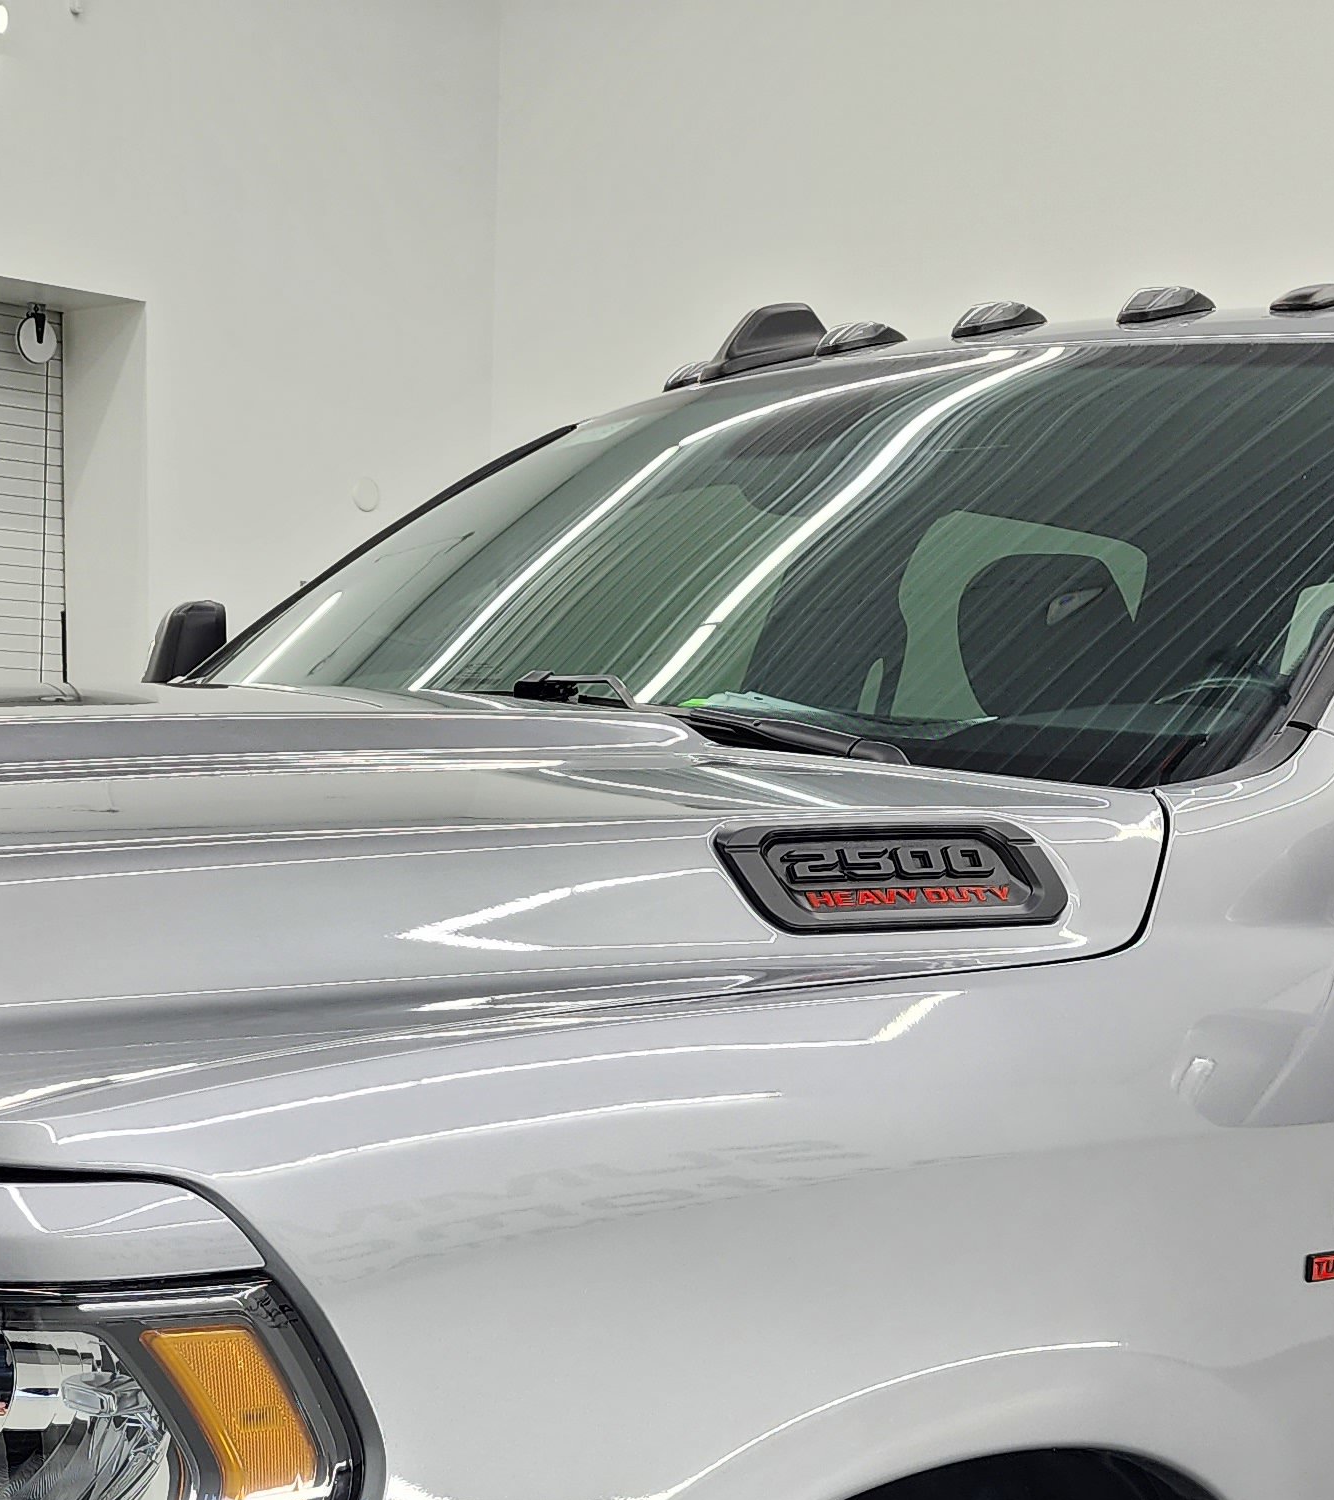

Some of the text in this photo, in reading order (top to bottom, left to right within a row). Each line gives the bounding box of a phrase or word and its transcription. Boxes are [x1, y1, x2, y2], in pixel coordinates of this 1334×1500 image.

[780, 846, 995, 884] 2500
[805, 885, 1010, 908] HEAVY DUTY
